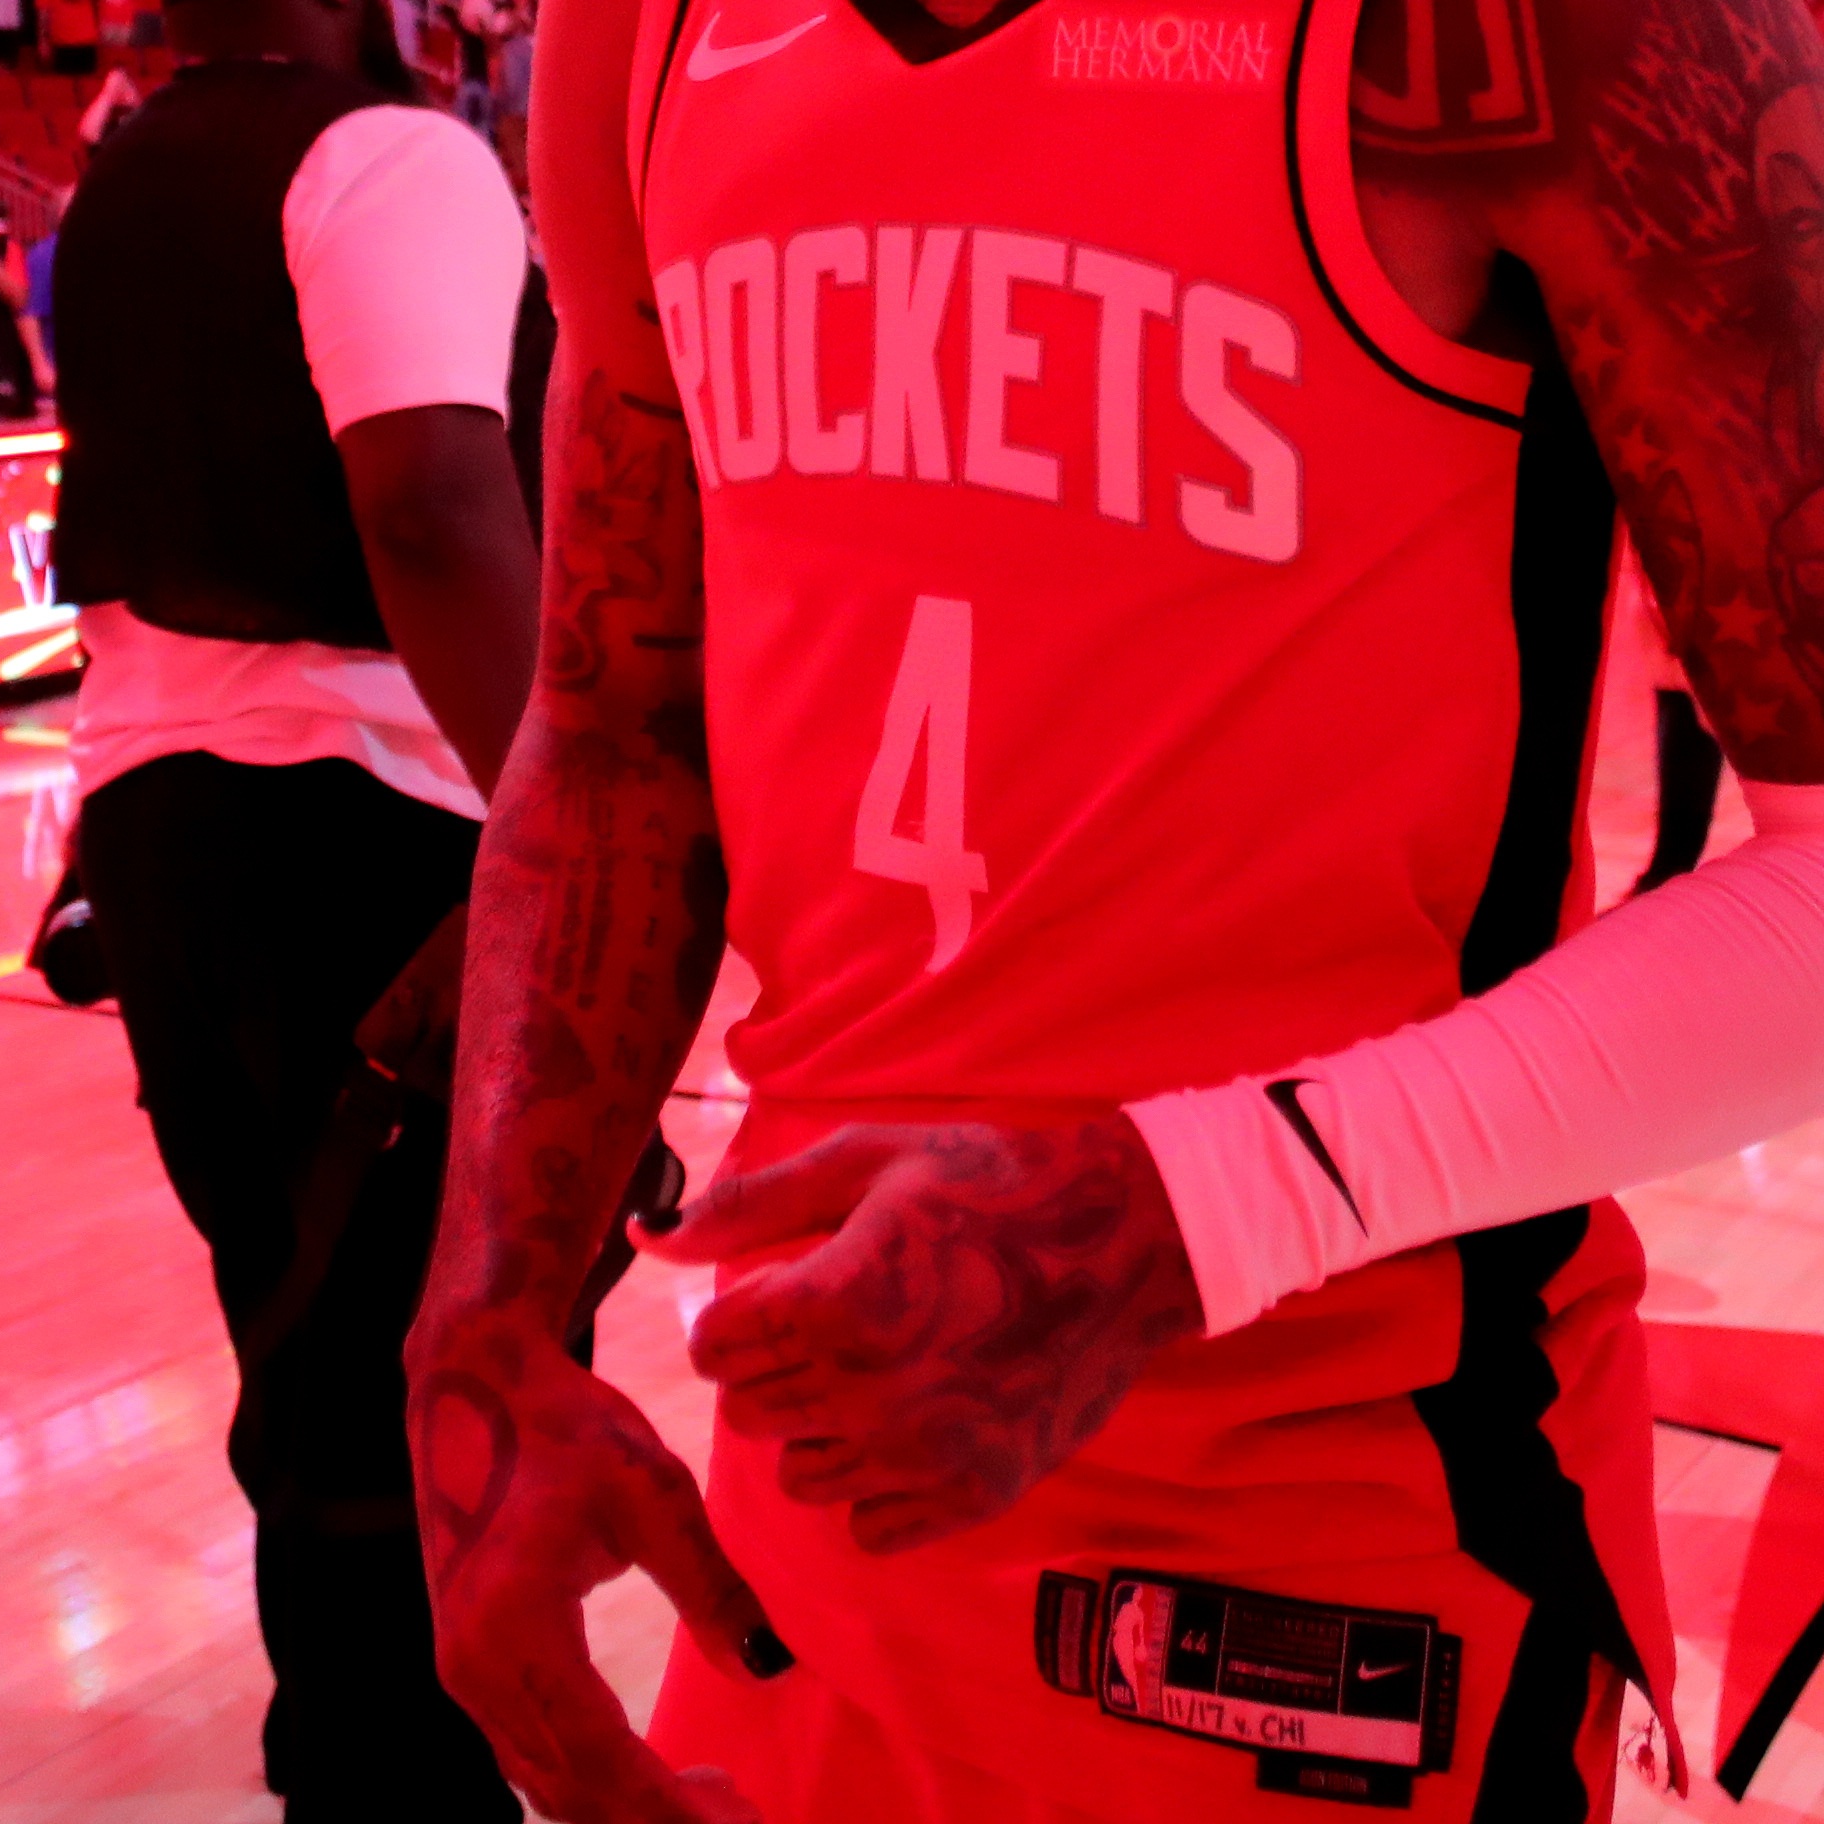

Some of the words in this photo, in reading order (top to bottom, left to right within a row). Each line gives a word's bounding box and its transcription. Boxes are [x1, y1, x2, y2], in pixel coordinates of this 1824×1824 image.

[1053, 14, 1270, 56] MEMORIAL
[1049, 46, 1273, 83] HERMANN
[651, 220, 1303, 566] ROCKETS
[851, 593, 990, 977] 4
[1167, 1692, 1225, 1732] 11/17
[1260, 1713, 1306, 1747] CHI
